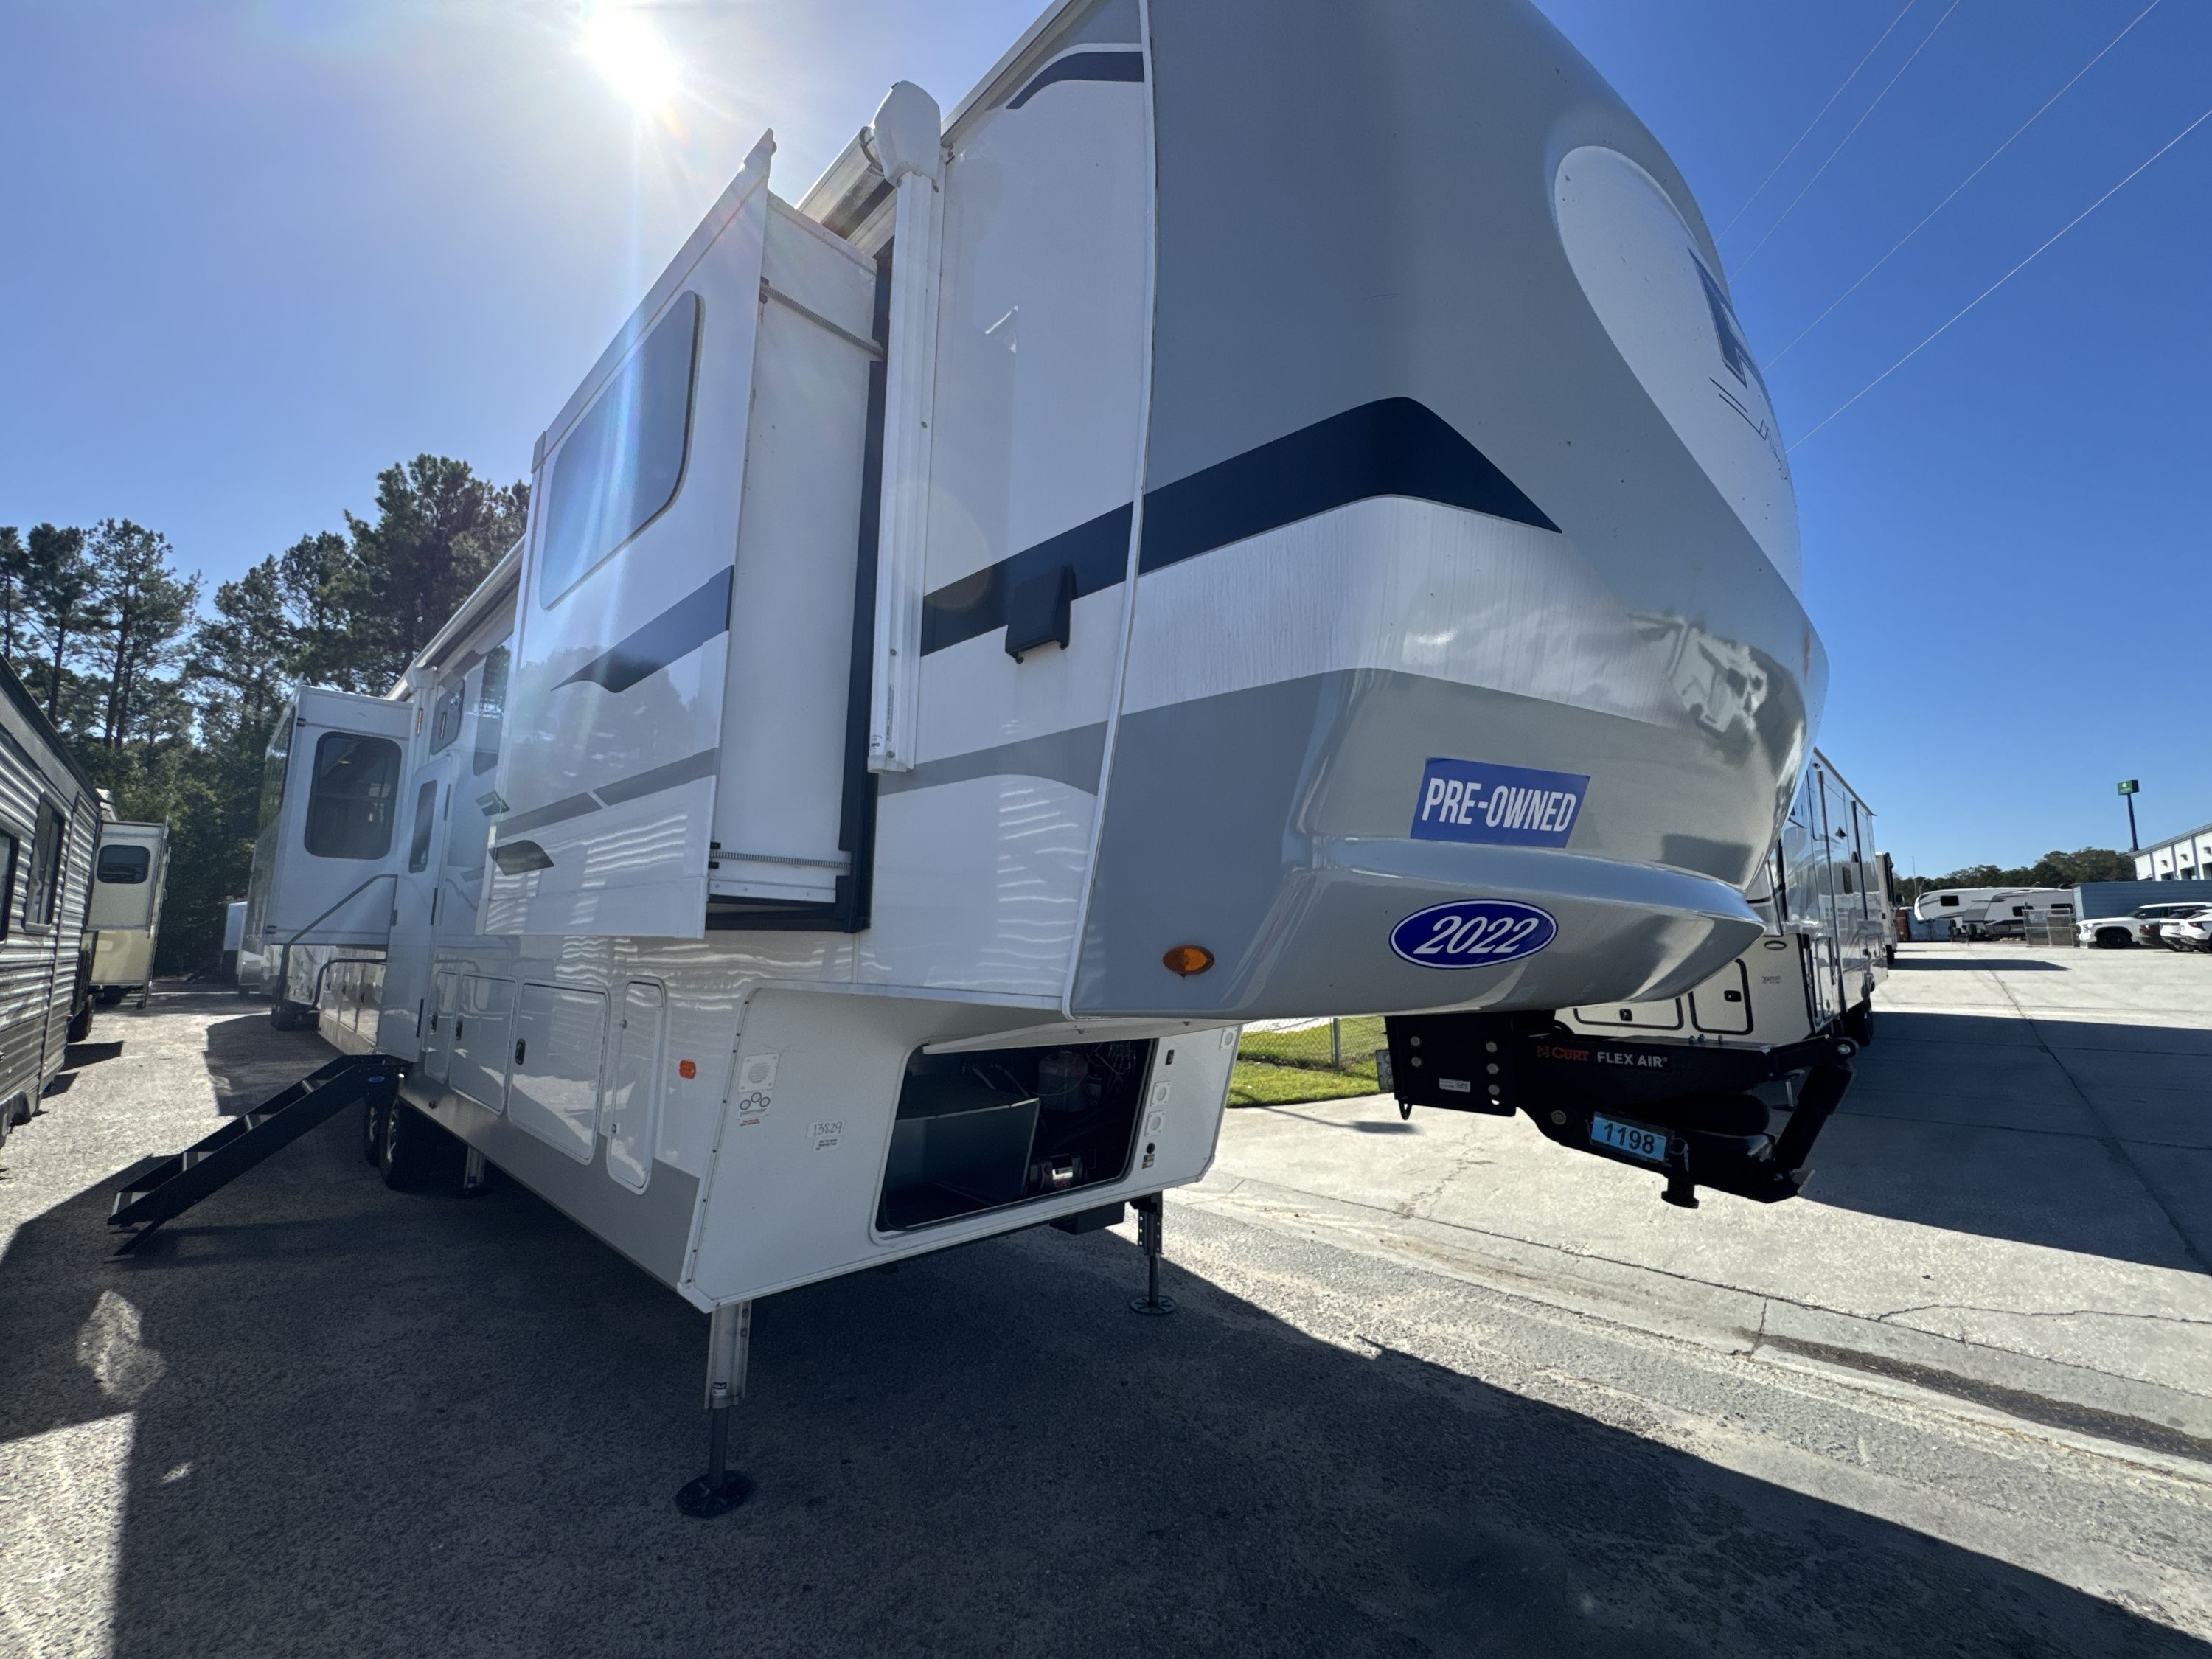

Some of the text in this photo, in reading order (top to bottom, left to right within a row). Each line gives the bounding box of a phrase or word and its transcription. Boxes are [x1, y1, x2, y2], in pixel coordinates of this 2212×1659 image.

[1422, 777, 1576, 832] PRE-OWNED
[1413, 915, 1539, 954] 2022
[1551, 1046, 1590, 1061] CURT
[1596, 1051, 1635, 1065] FLEX
[814, 1121, 843, 1136] 13829
[1604, 1122, 1655, 1154] 1198
